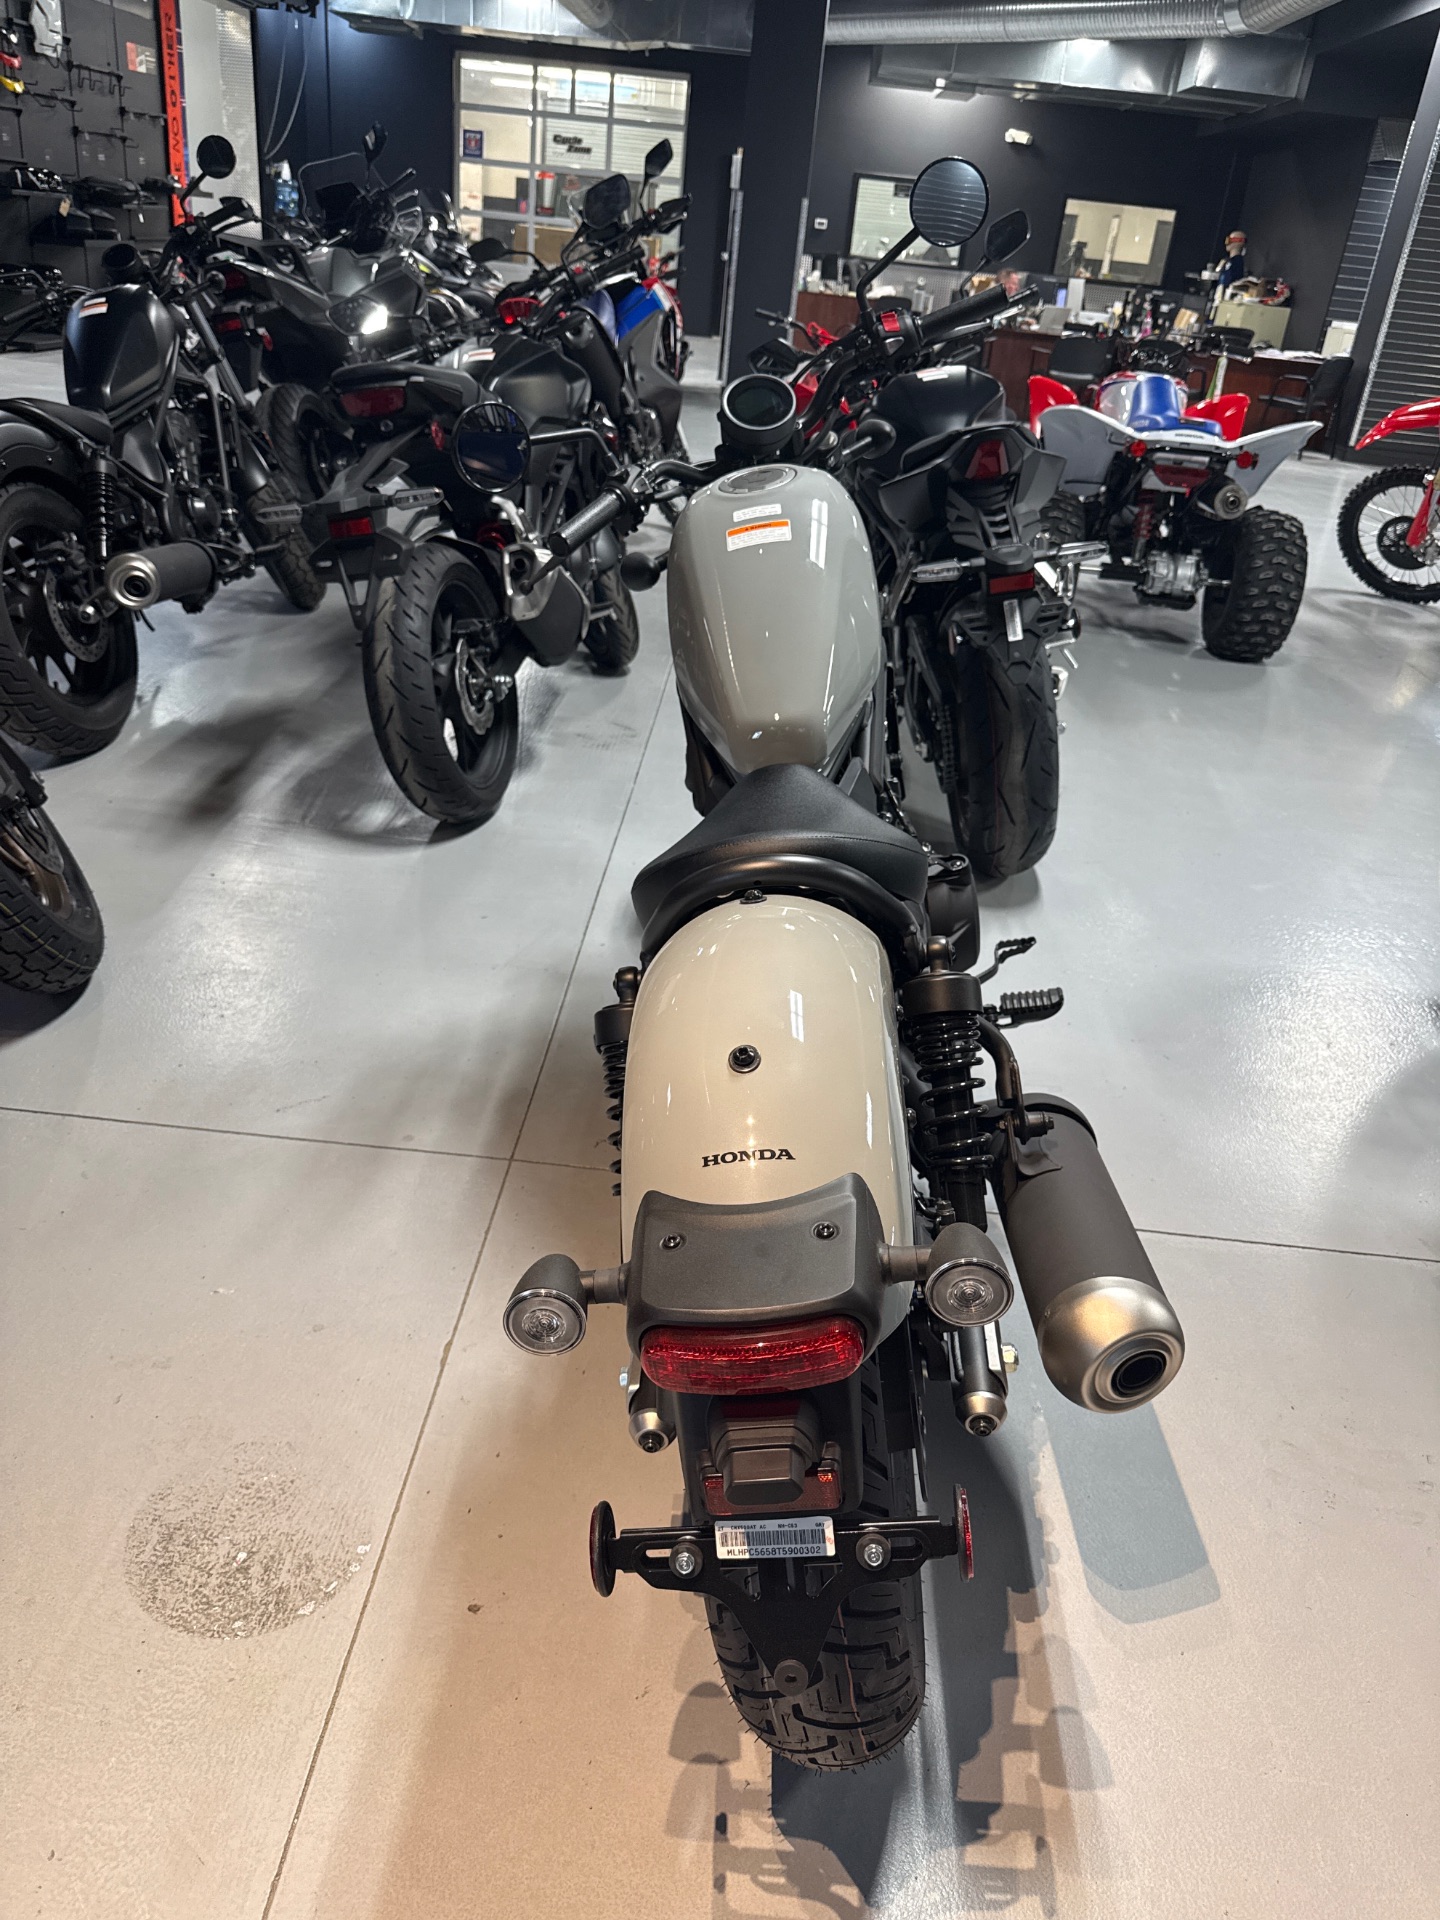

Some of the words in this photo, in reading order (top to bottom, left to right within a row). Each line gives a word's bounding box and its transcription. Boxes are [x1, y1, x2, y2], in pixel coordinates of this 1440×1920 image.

[165, 12, 178, 108] OTHER
[171, 119, 181, 153] NO
[553, 134, 583, 145] Cycle
[566, 145, 592, 155] Zone
[702, 1149, 796, 1167] HONDA
[727, 1546, 821, 1556] MLHPC5658T5900302
